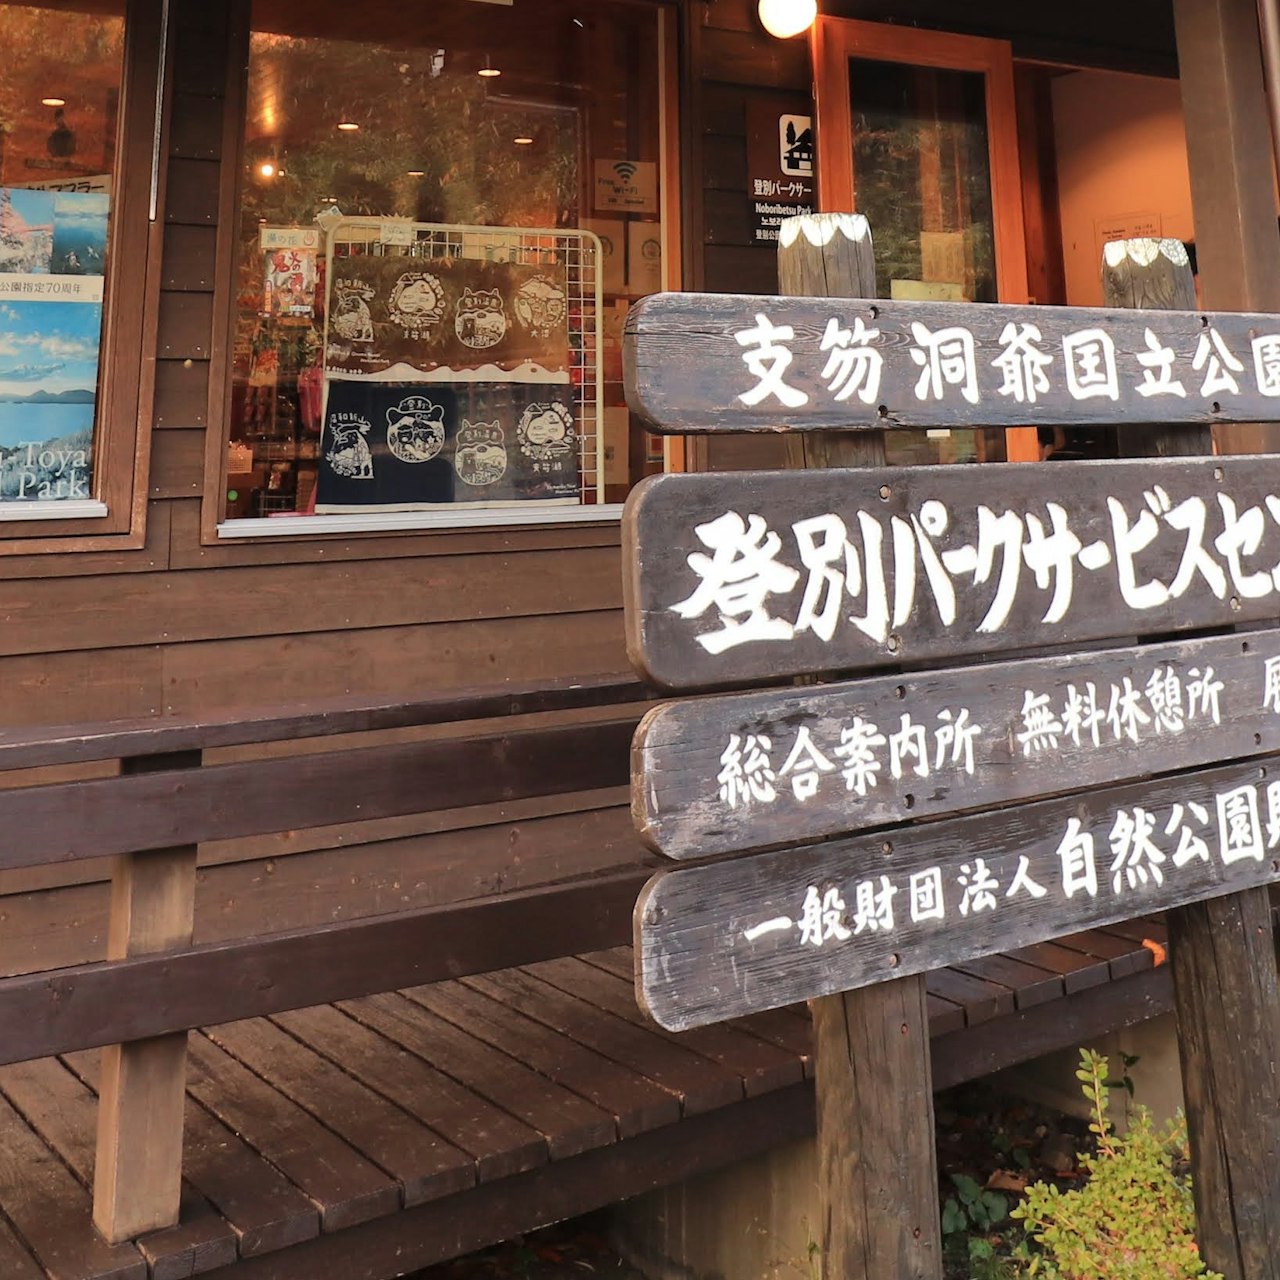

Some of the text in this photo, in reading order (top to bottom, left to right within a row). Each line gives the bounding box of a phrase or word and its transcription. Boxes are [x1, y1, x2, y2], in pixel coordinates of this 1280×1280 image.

[16, 470, 89, 501] Park
[717, 707, 982, 809] 総合案内所
[1018, 665, 1226, 757] 無料休憩所
